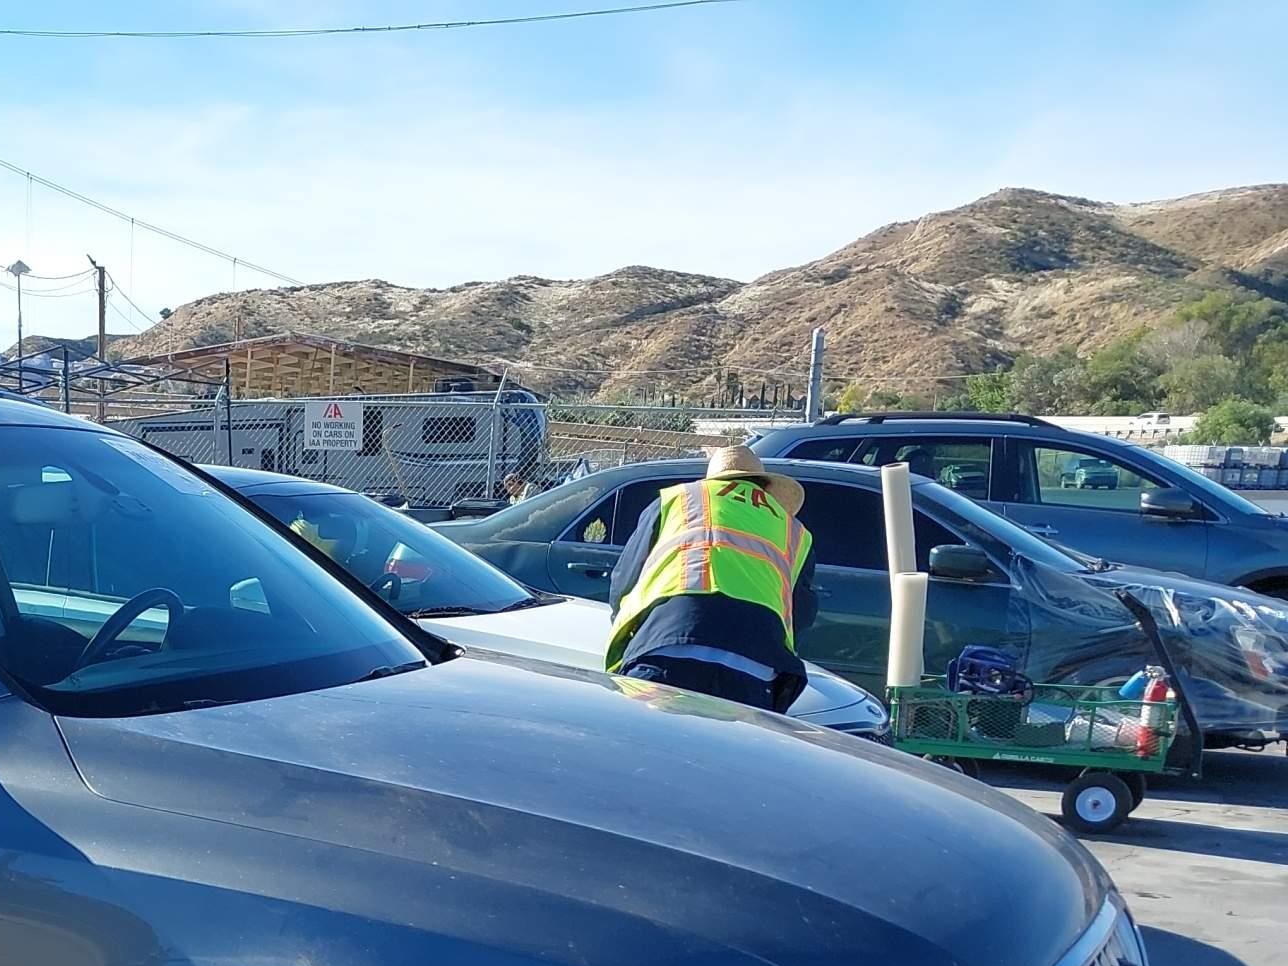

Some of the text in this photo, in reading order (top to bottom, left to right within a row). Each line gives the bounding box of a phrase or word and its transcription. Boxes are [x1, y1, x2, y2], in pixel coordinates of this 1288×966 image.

[311, 421, 356, 430] NO WORKING
[312, 430, 355, 439] ON CARS ON
[309, 439, 358, 448] IAA PROPERTY
